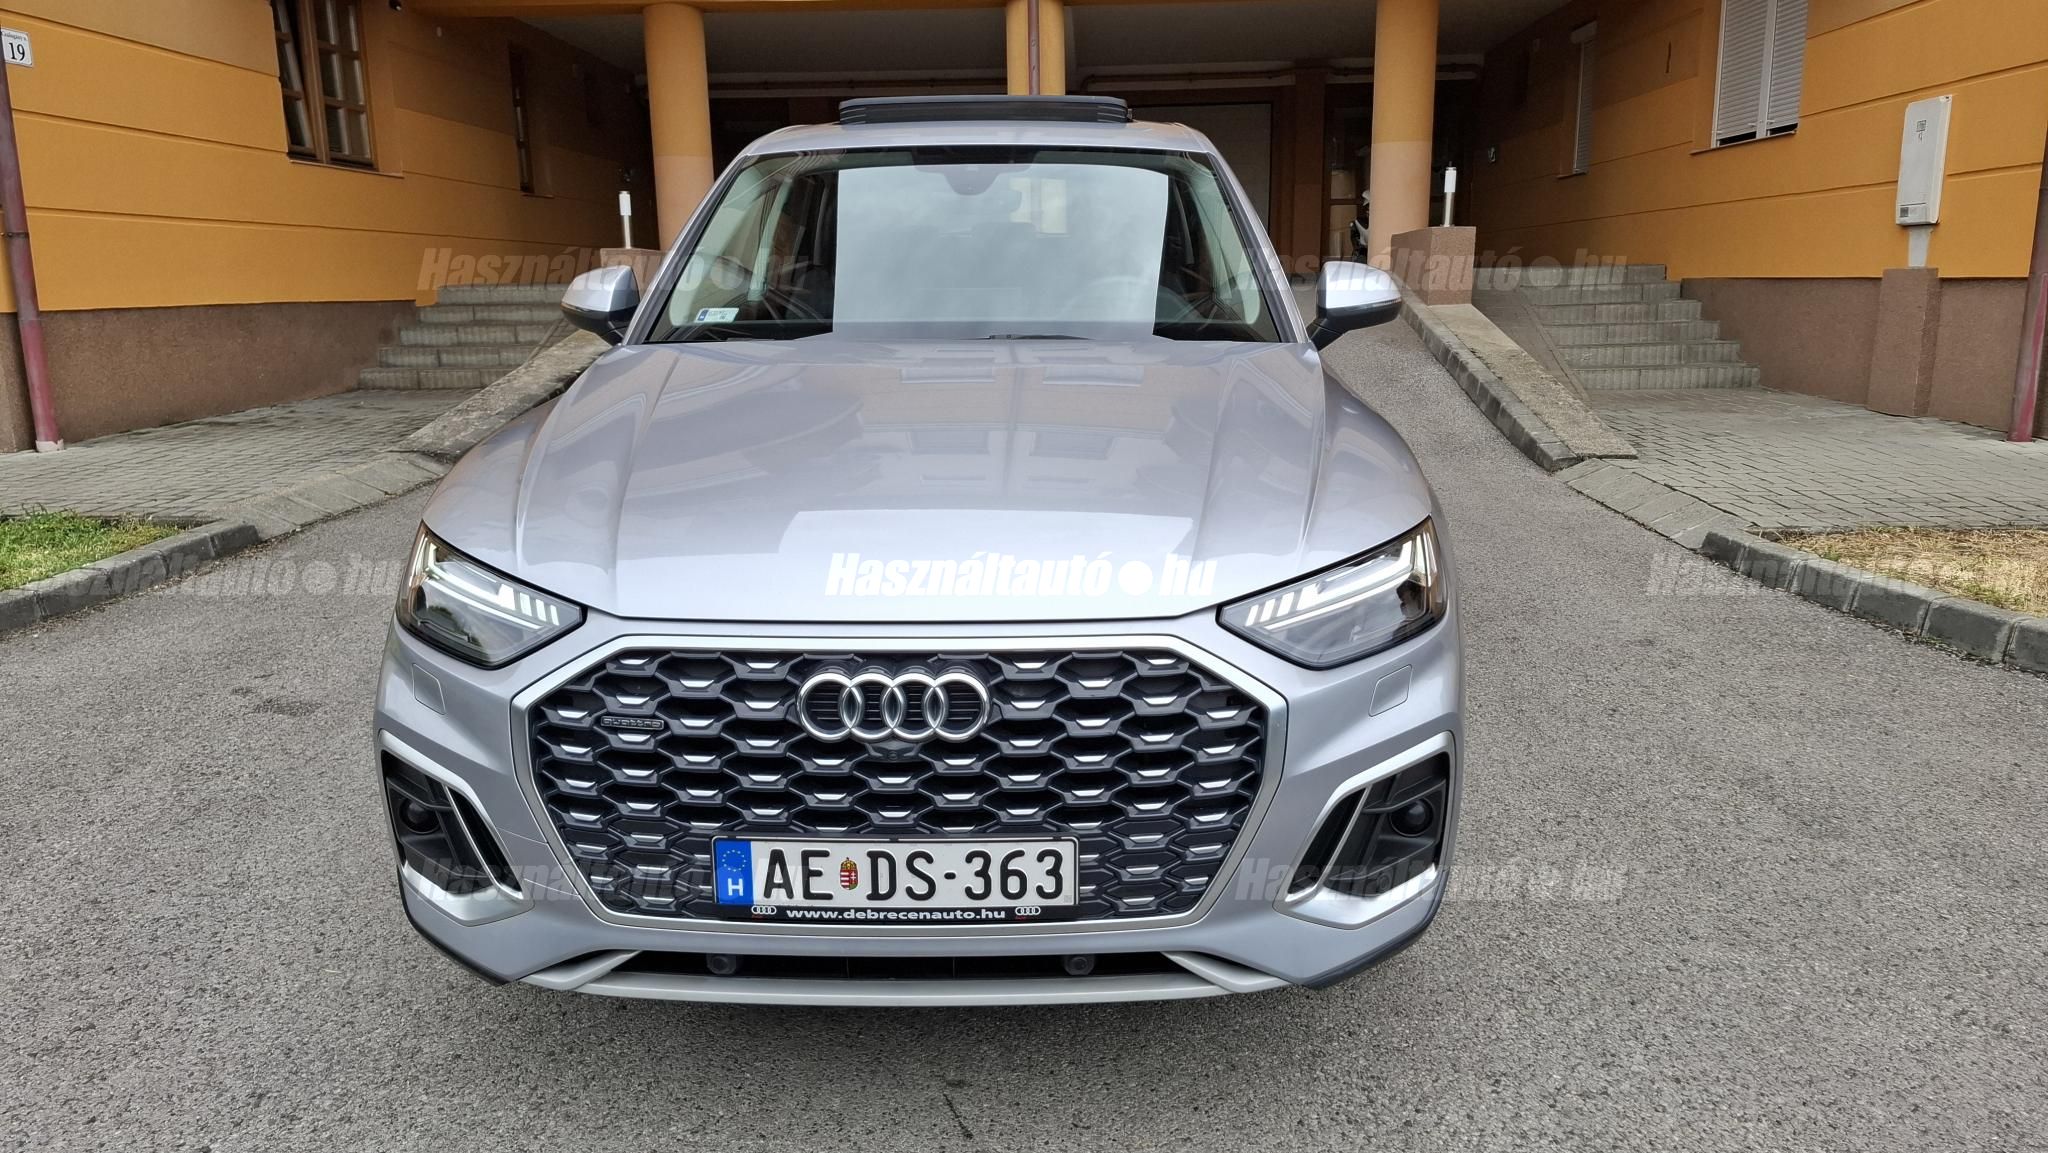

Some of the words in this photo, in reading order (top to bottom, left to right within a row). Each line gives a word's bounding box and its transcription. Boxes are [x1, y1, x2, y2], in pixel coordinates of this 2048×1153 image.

[8, 42, 26, 62] 19
[763, 848, 834, 900] AE
[866, 849, 1063, 901] DS-363
[727, 878, 744, 896] H
[786, 908, 1006, 920] www.debrecenauto.hu
